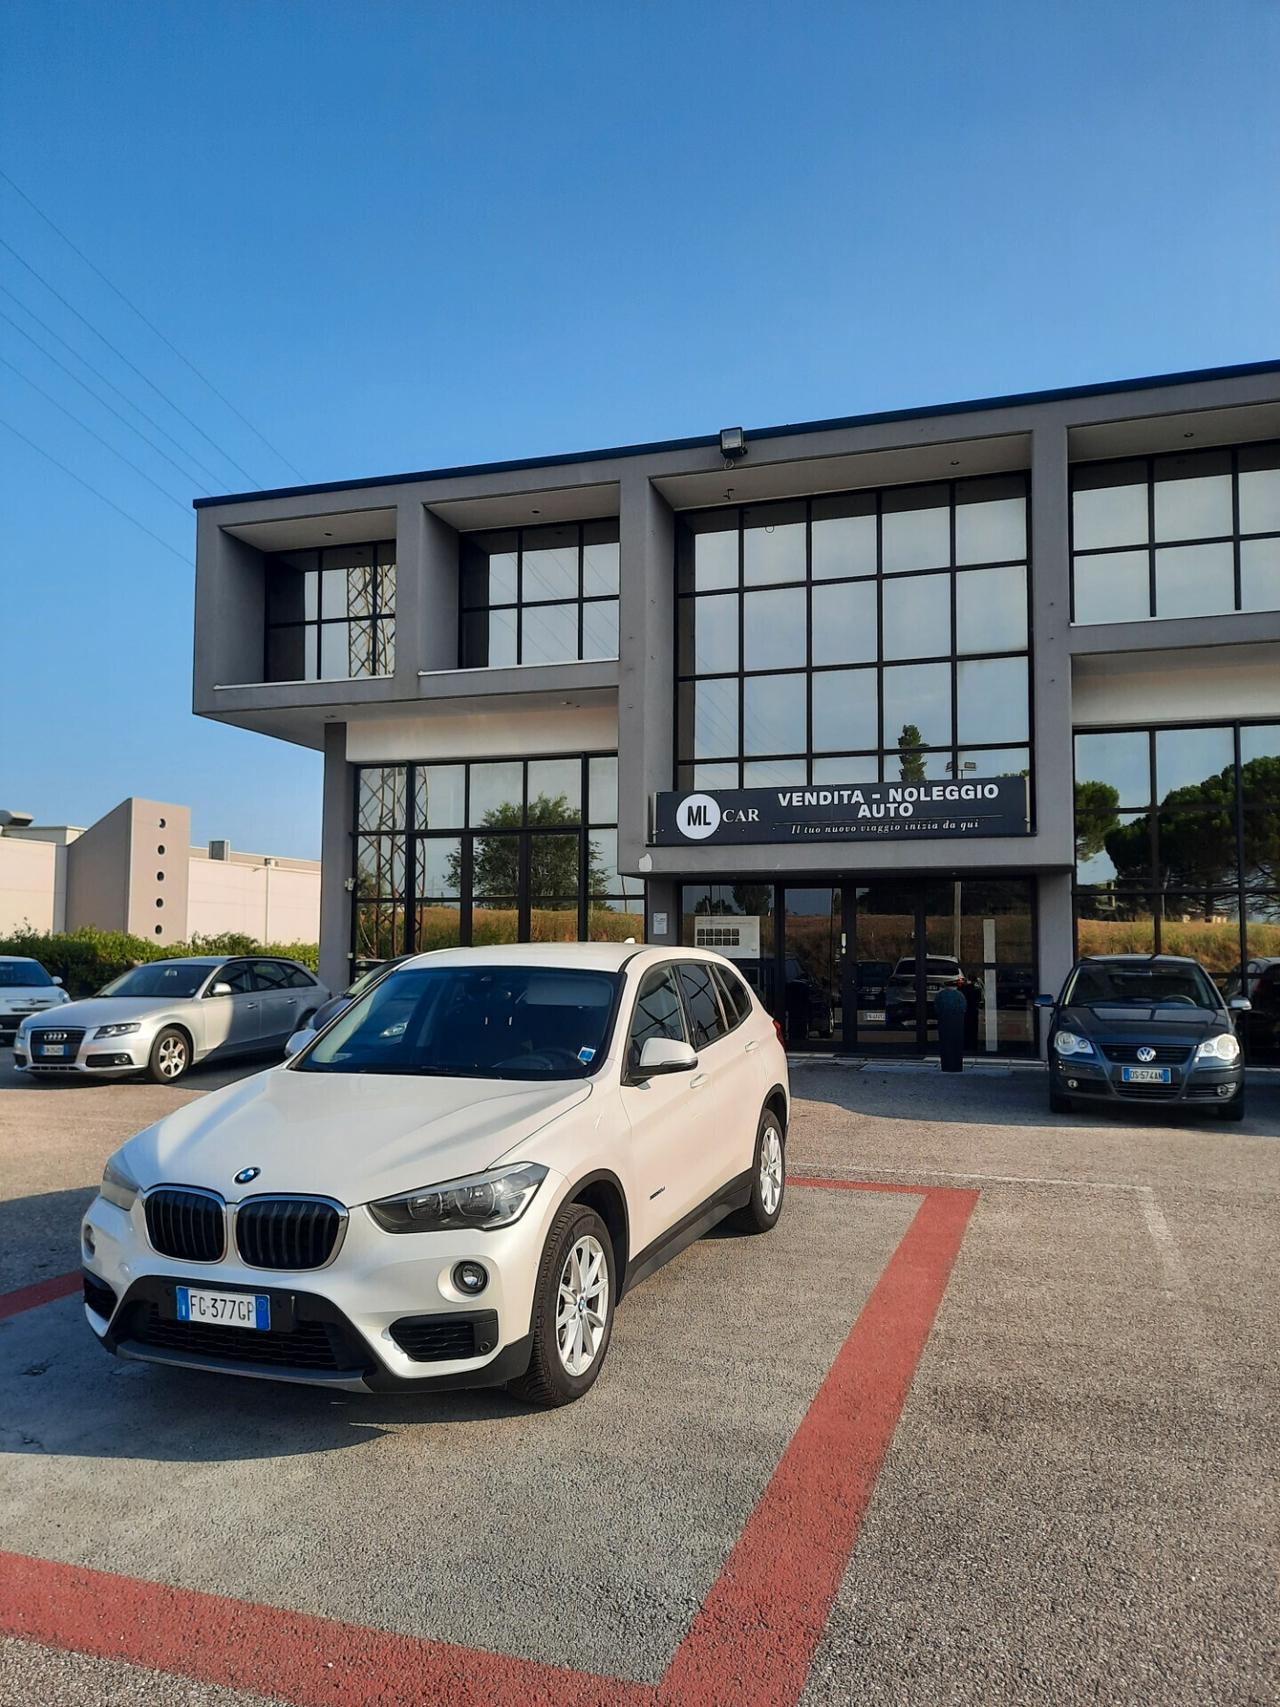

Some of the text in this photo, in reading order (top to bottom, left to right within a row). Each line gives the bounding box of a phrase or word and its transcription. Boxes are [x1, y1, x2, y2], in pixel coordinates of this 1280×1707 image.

[778, 791, 864, 806] VENDITA
[888, 783, 999, 802] NOLEGGIO
[687, 805, 760, 826] ML CAR
[857, 802, 914, 818] AUTO
[791, 819, 979, 834] Il tuo nuovo viaggio inizia da qui
